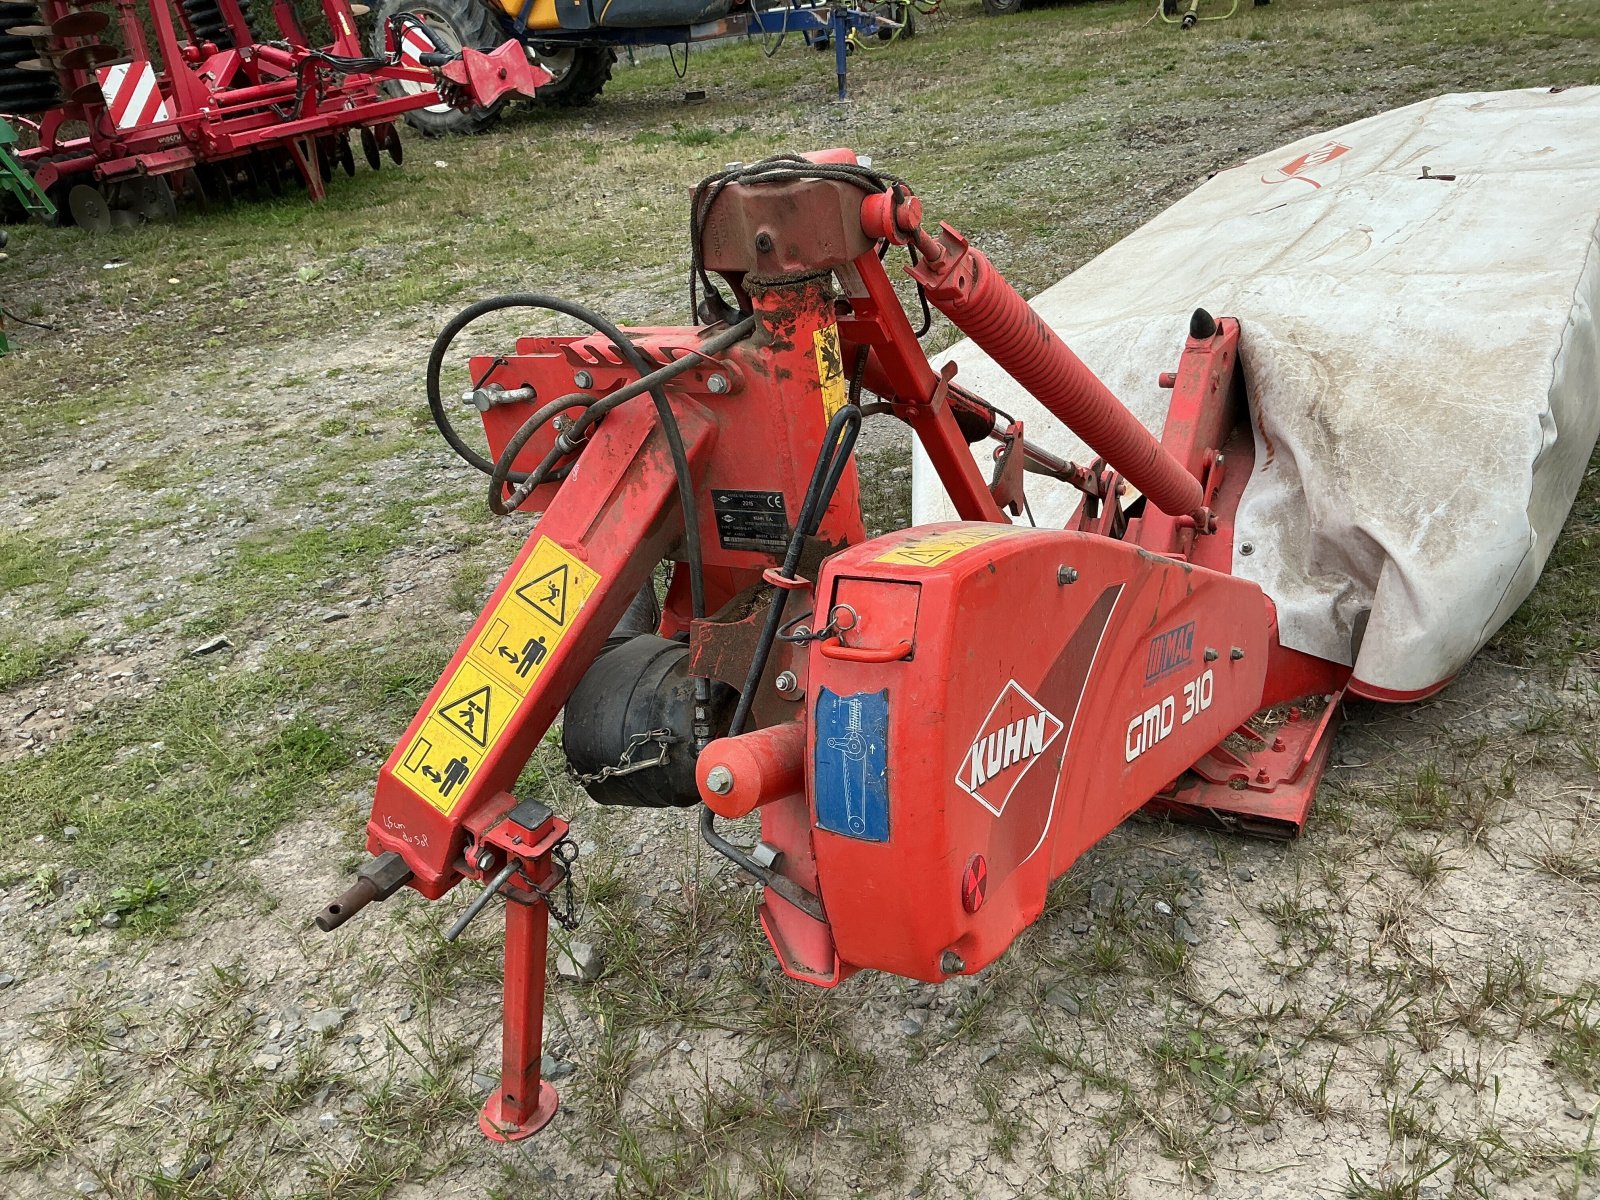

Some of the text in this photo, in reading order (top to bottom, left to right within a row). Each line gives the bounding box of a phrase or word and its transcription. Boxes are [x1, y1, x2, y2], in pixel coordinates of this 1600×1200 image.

[767, 495, 782, 508] CE
[971, 711, 1047, 793] KUHN
[1125, 669, 1214, 763] GMD 310
